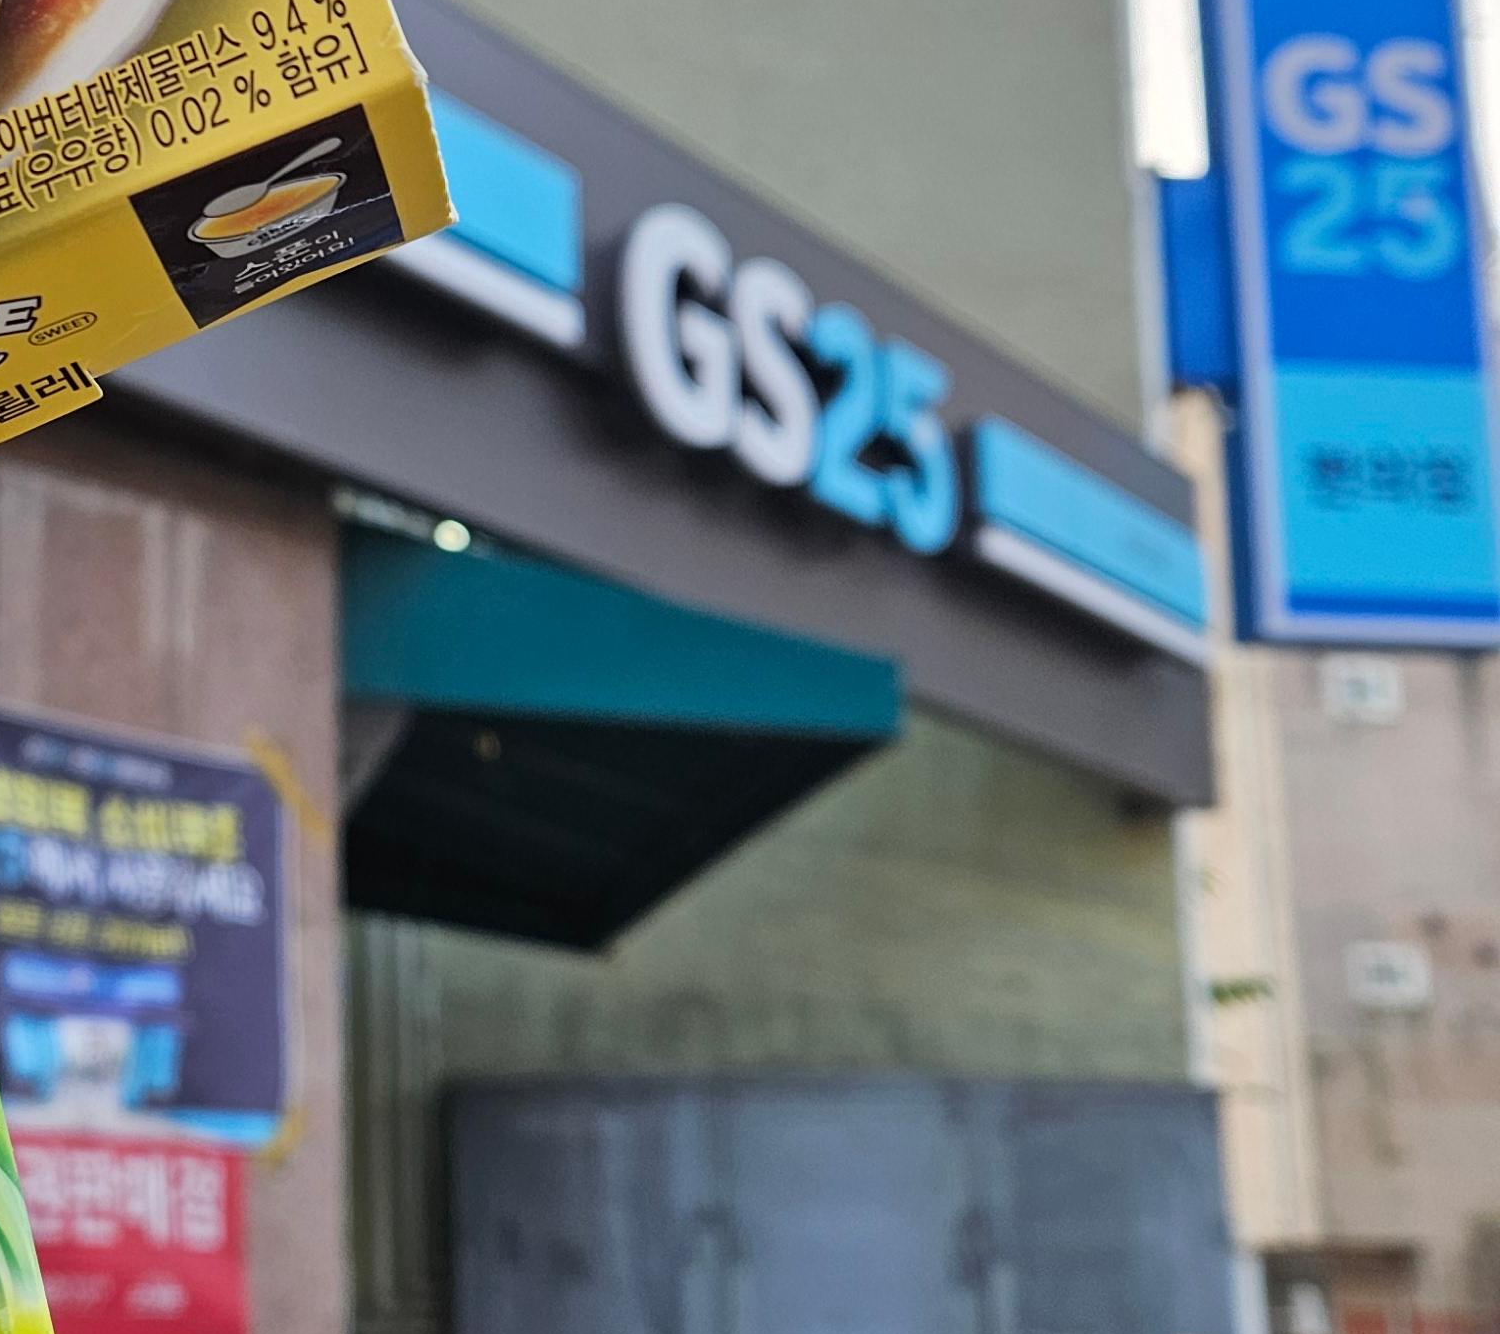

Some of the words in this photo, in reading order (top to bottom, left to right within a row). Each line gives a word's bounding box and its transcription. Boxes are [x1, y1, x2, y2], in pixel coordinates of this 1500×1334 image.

[151, 86, 231, 150] 0.02
[234, 69, 272, 115] %
[275, 22, 370, 101] 함유]
[1263, 33, 1456, 157] GS
[233, 229, 339, 284] 스푼이
[1275, 159, 1464, 280] 25
[33, 314, 92, 344] SWEET
[620, 202, 961, 557] GS25
